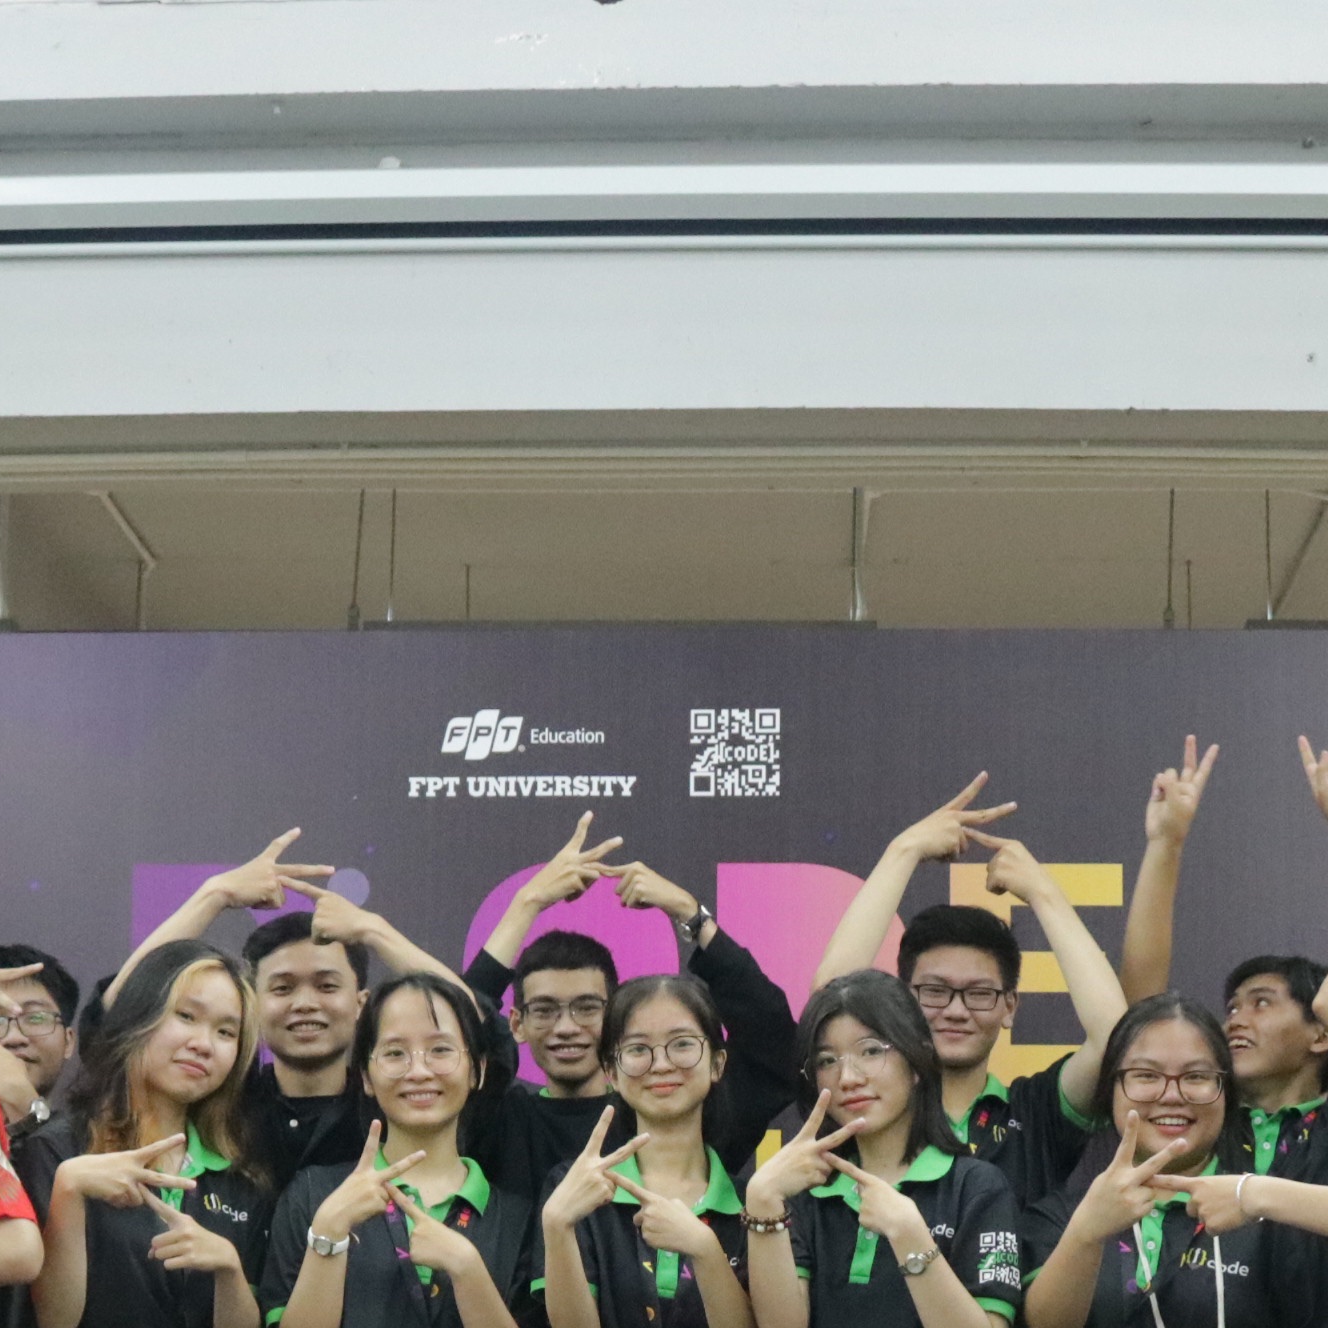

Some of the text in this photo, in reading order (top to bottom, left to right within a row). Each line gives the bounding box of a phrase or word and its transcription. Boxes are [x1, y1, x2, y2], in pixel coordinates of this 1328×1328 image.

[529, 727, 606, 744] Education
[408, 775, 637, 797] FPT UNIVERSITY
